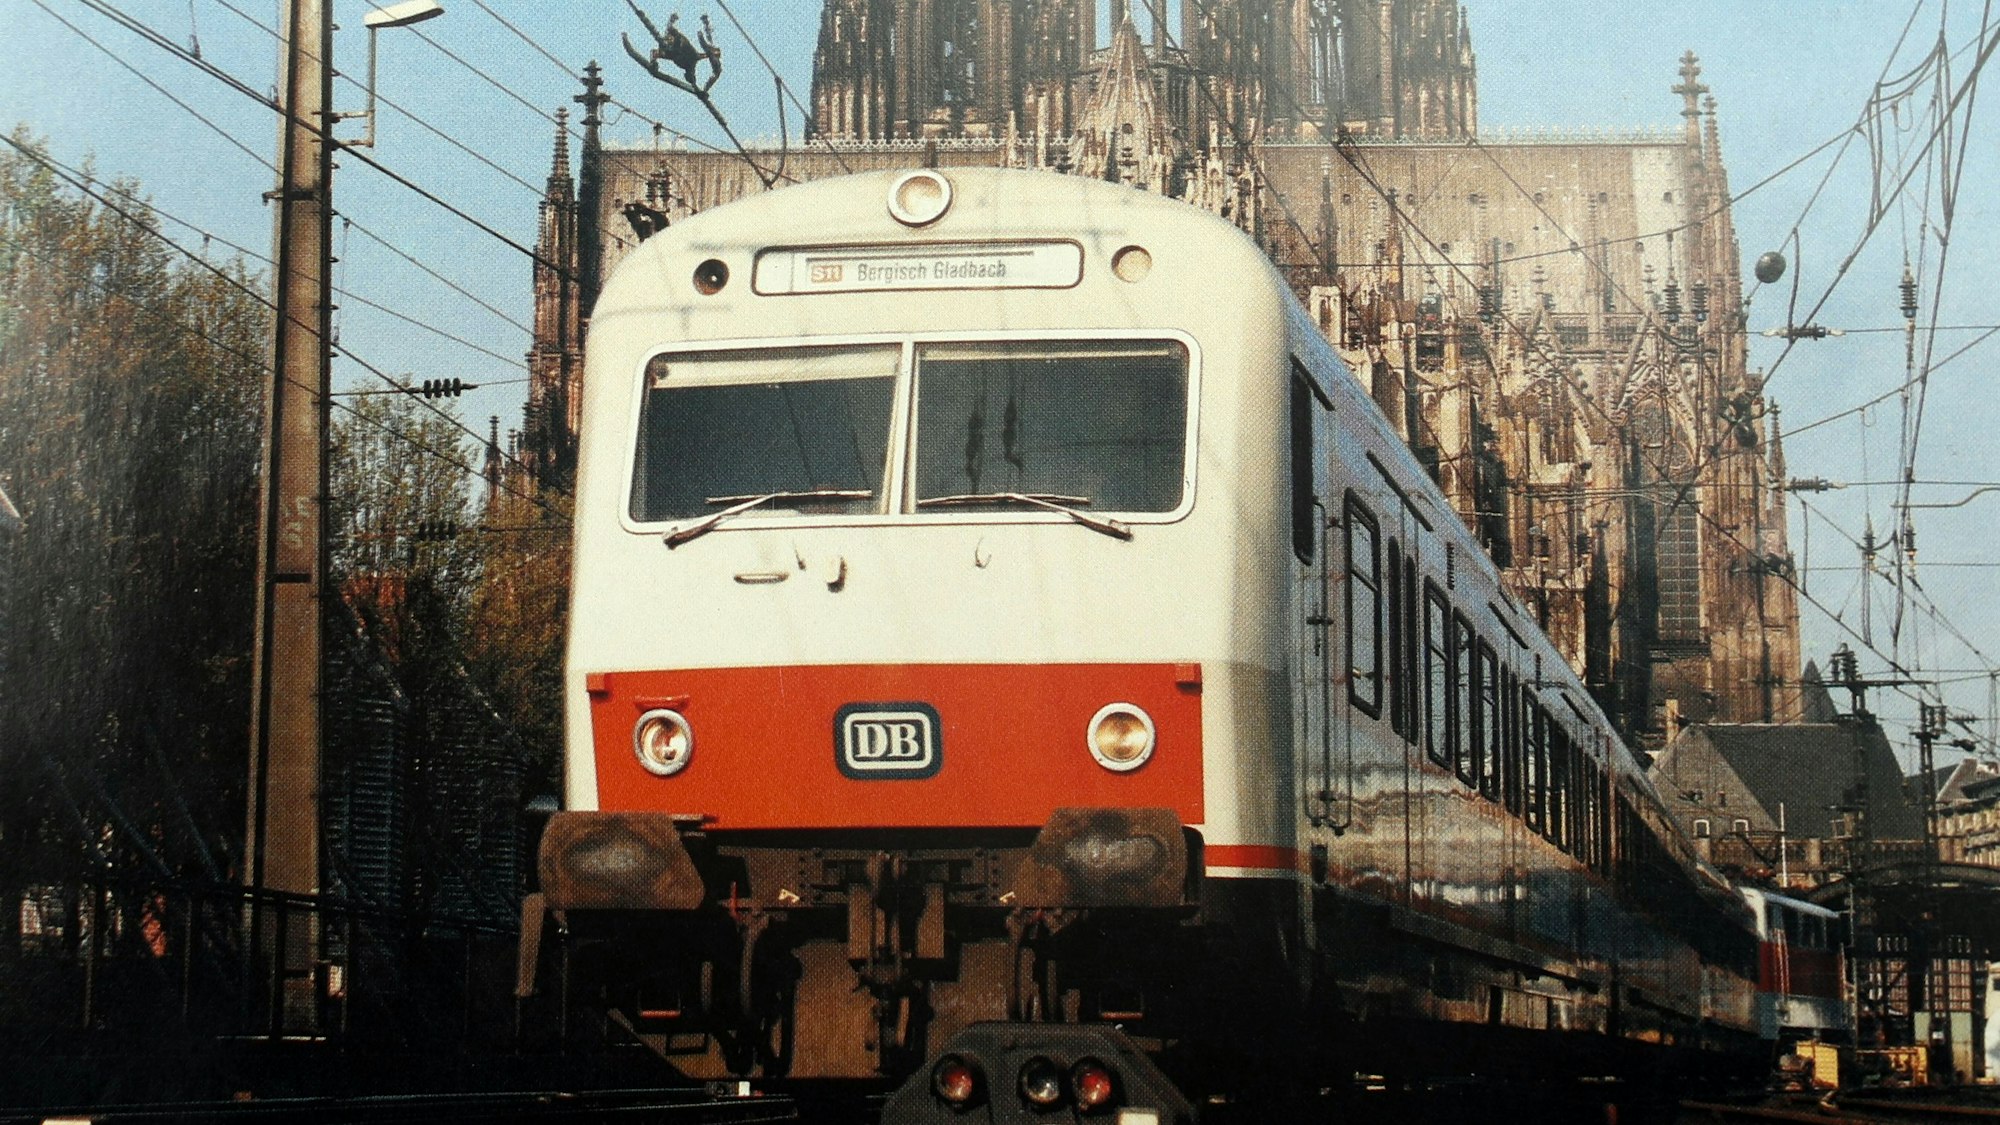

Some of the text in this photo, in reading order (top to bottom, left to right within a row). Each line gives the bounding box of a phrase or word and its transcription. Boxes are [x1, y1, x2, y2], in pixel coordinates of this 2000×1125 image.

[812, 259, 1007, 284] S11 Bergisch Gladbach
[854, 723, 920, 758] DB
